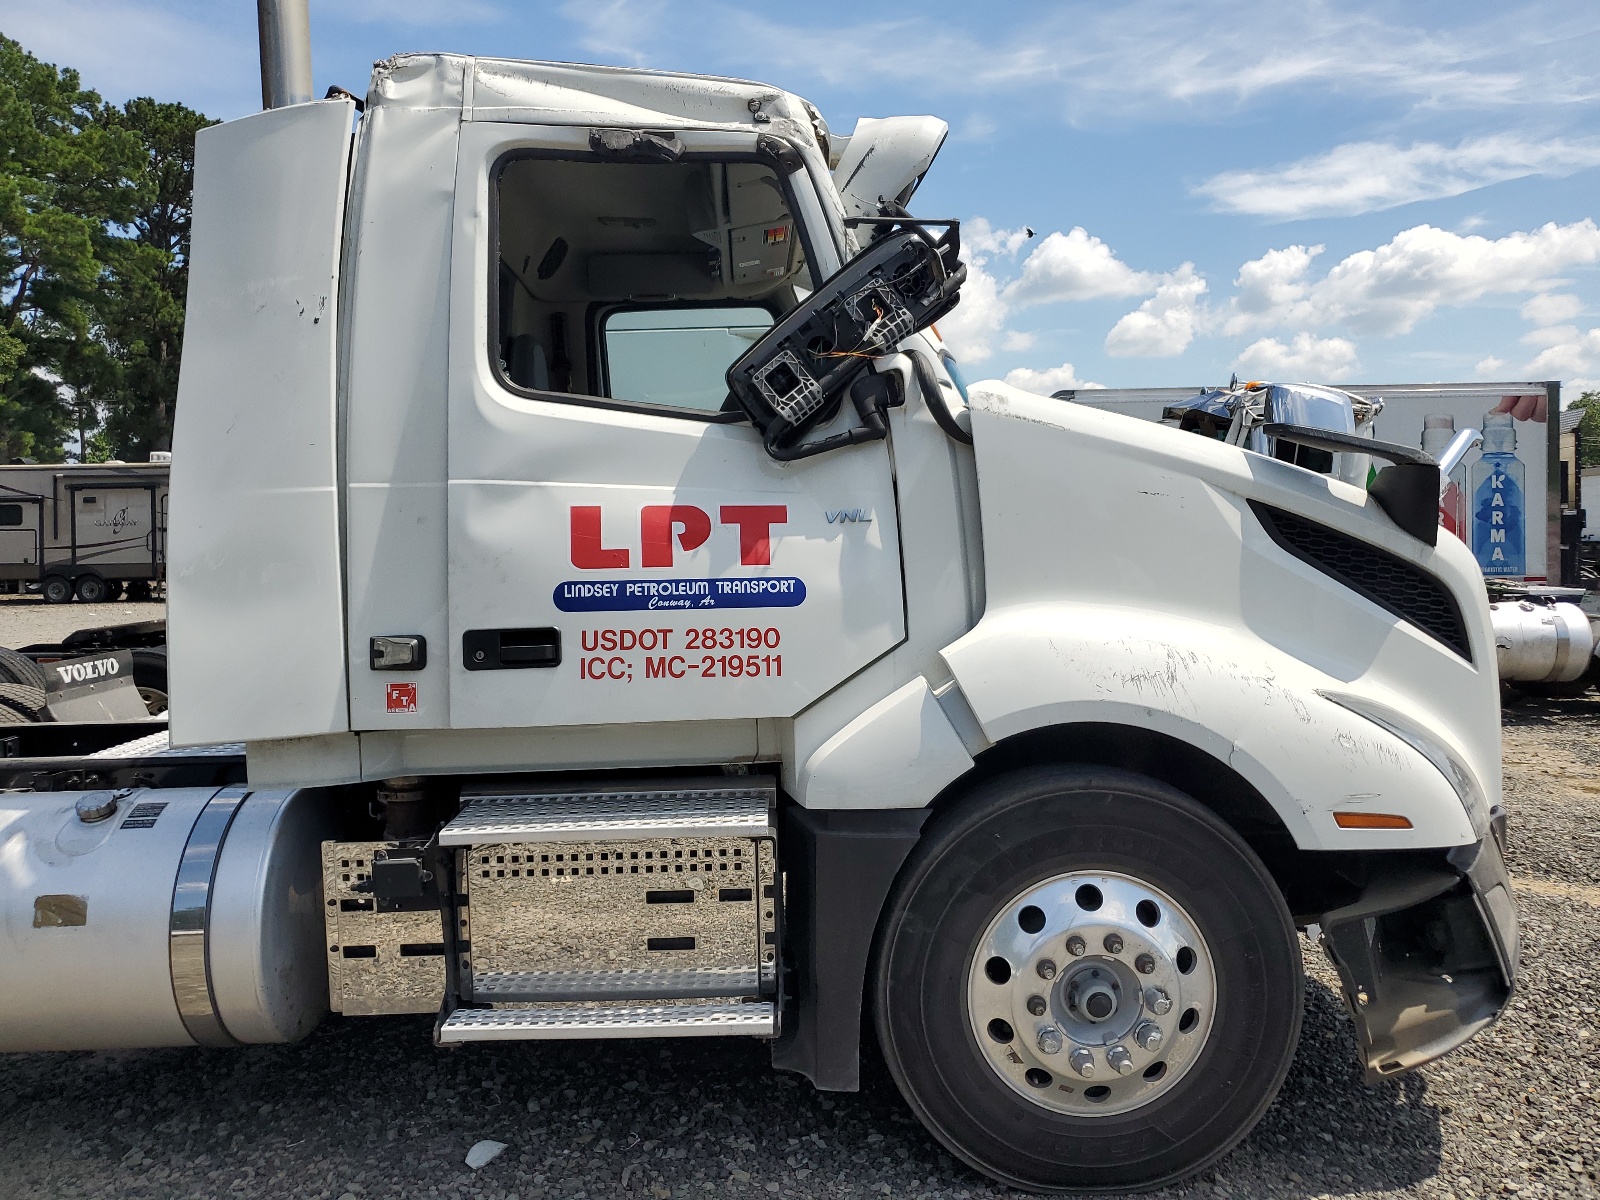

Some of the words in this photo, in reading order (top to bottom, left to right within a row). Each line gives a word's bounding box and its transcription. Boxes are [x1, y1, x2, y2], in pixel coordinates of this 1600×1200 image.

[825, 509, 873, 523] VNL
[1491, 475, 1505, 560] KARMA
[570, 505, 788, 569] LPT
[564, 583, 619, 598] LINDSEY
[626, 581, 709, 596] PETROLEUM
[716, 579, 796, 594] TRANSPORT
[648, 596, 695, 610] Conway,
[699, 595, 716, 607] Ar
[581, 628, 674, 651] USDOT
[685, 627, 781, 649] 283190
[56, 657, 119, 684] VOLVO
[580, 656, 633, 683] ICC;
[645, 654, 783, 679] MC-219511
